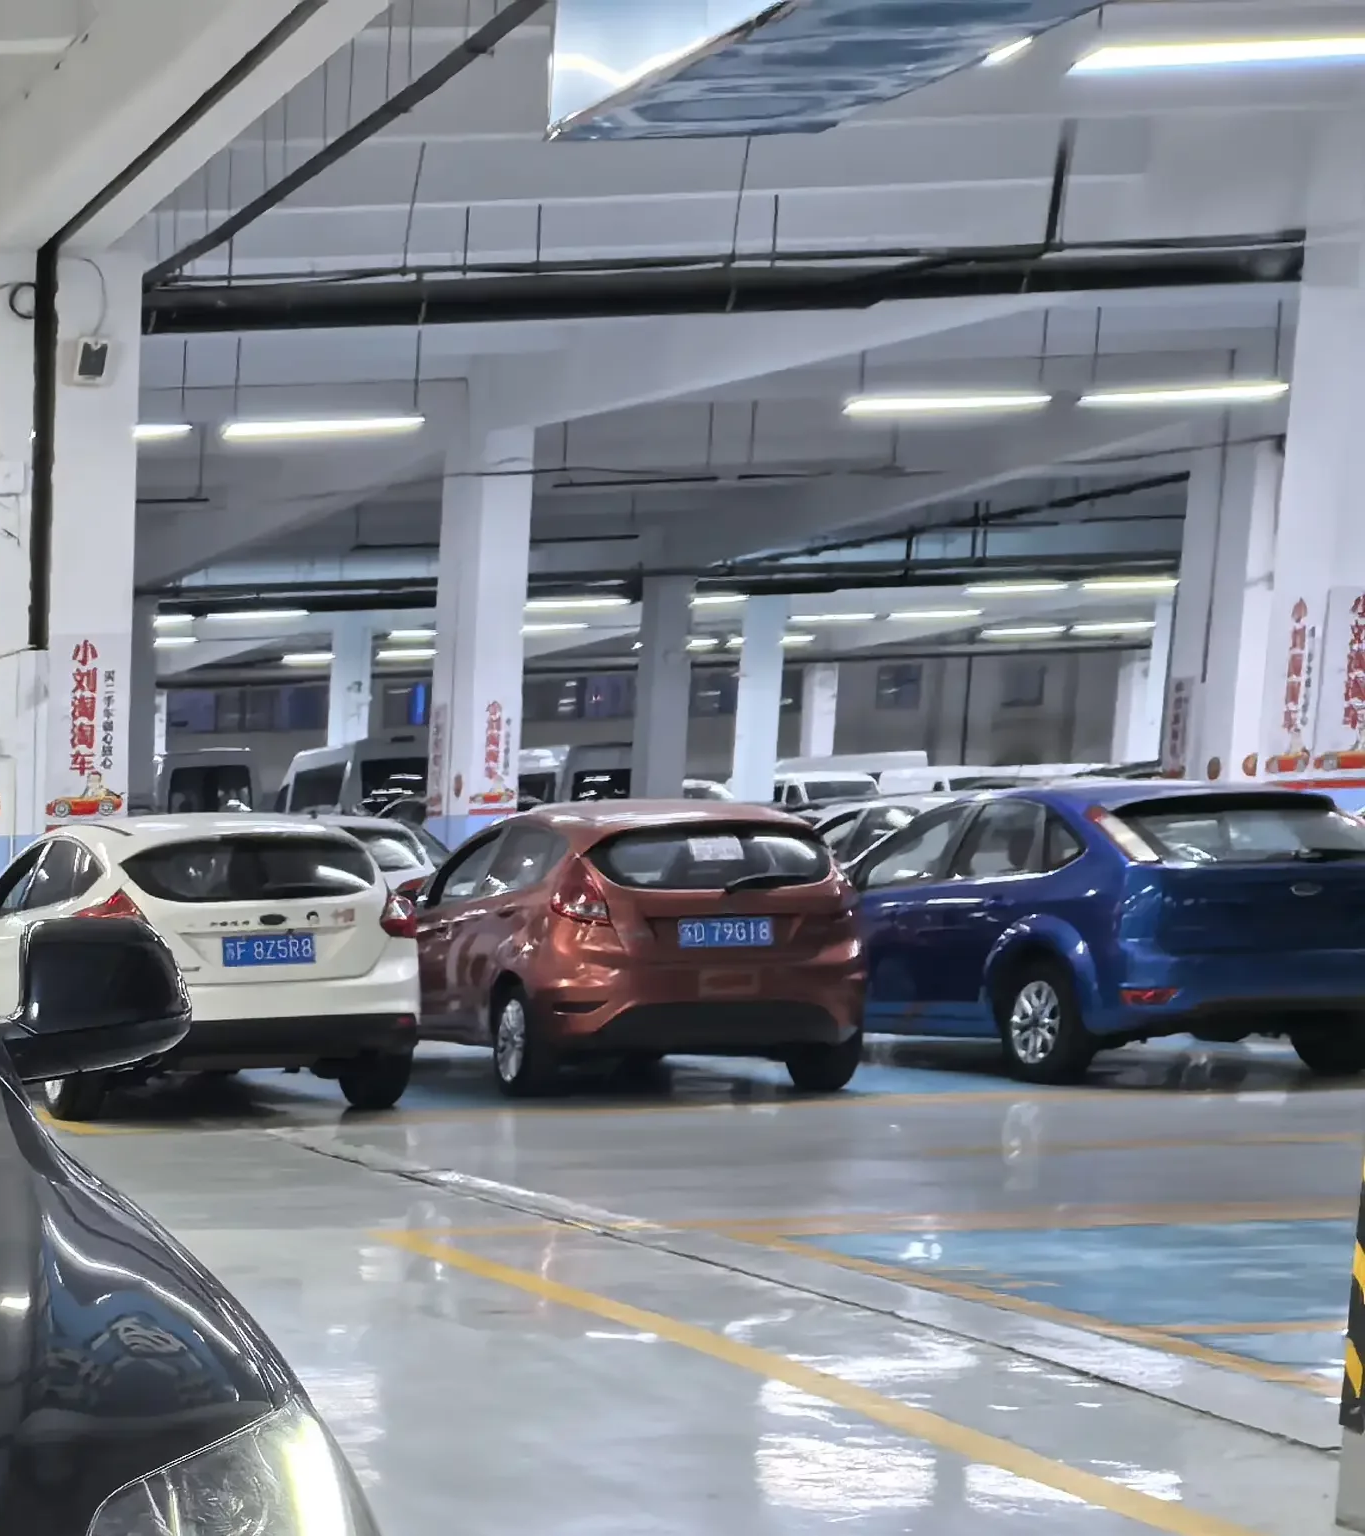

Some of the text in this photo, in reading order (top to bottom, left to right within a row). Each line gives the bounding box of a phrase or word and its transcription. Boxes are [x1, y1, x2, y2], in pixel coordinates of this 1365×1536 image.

[70, 639, 98, 776] 小刘淘淘车
